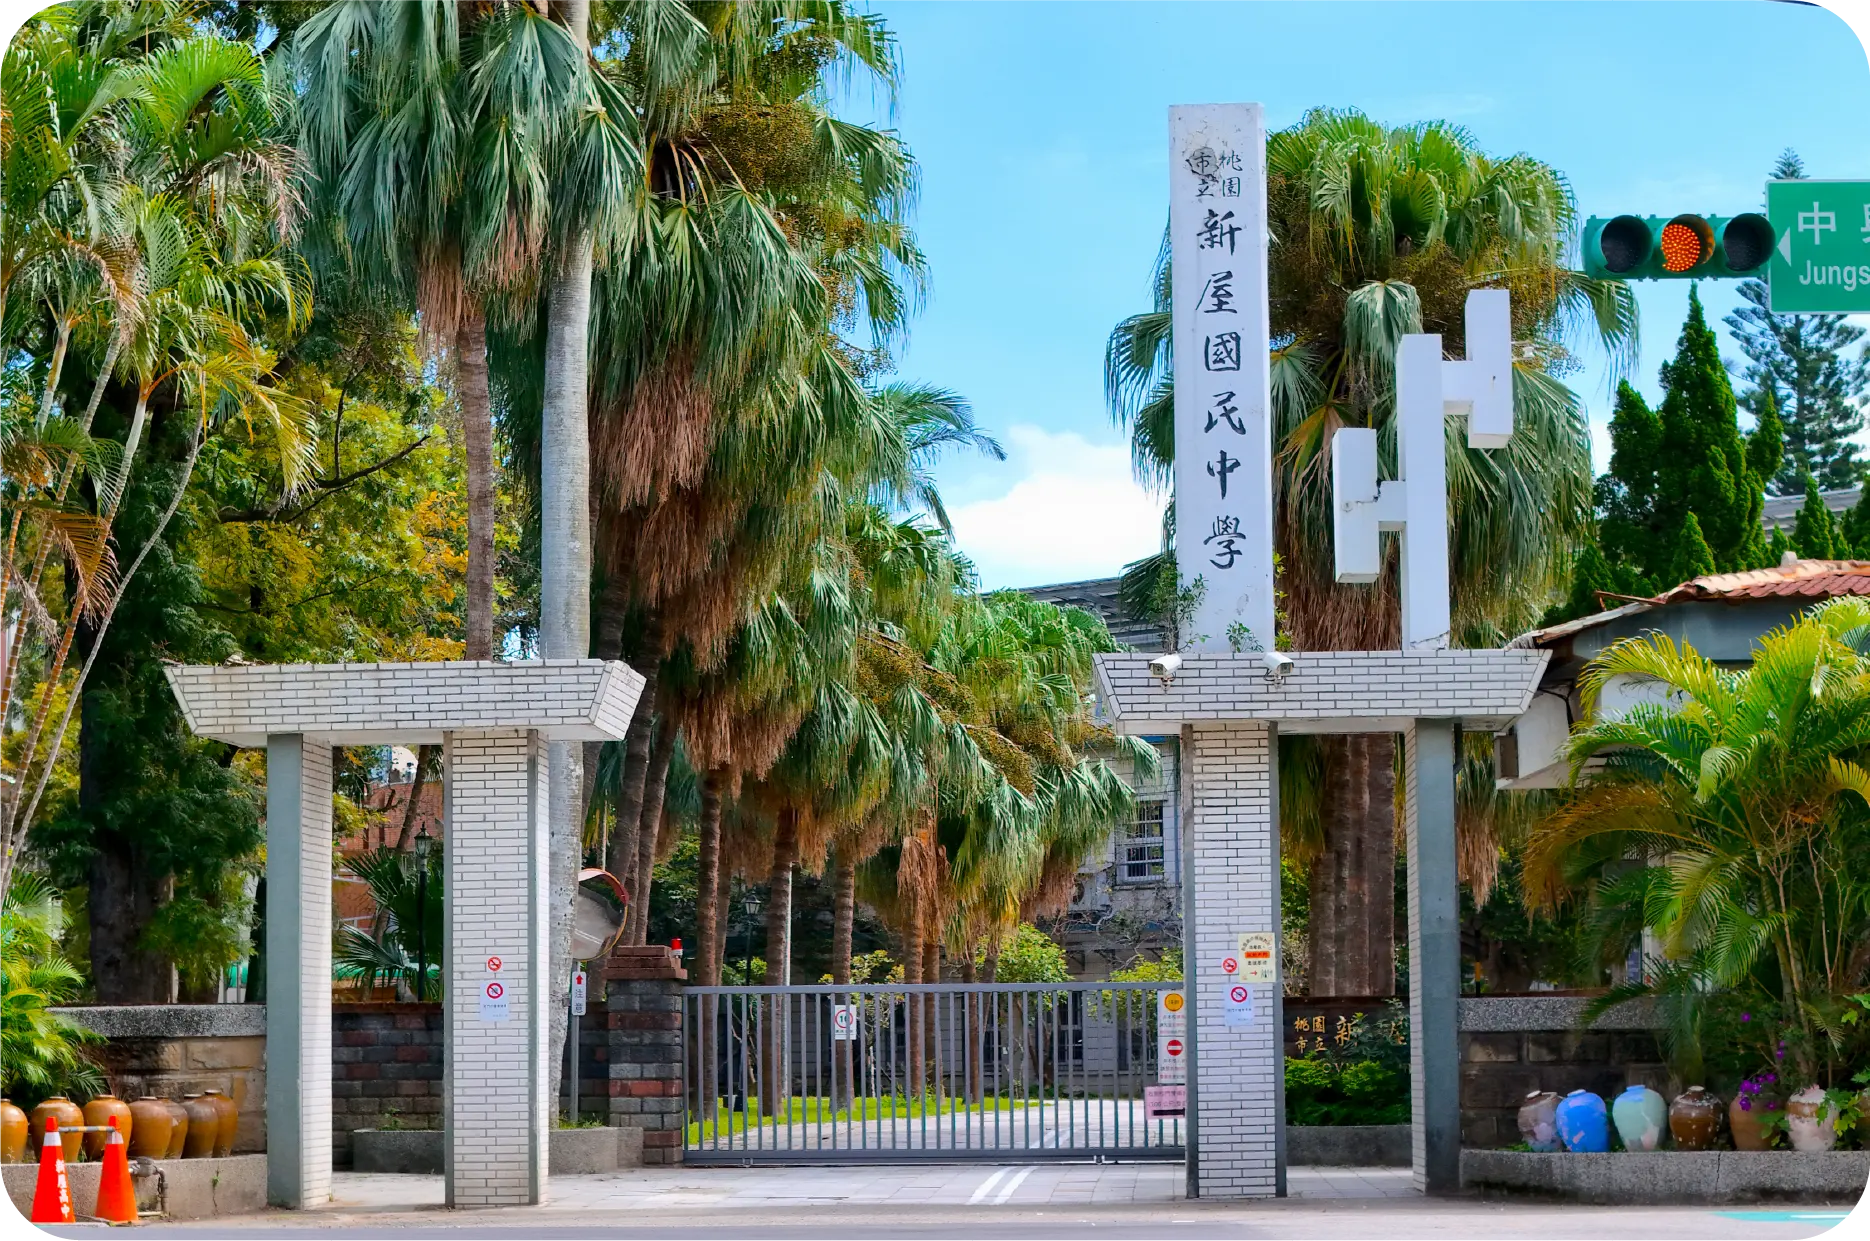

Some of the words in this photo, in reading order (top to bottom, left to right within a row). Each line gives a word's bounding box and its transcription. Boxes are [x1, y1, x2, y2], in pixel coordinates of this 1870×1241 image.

[1219, 149, 1243, 198] 桃園
[1797, 201, 1870, 246] 中
[1195, 208, 1247, 570] 新屋國民中學
